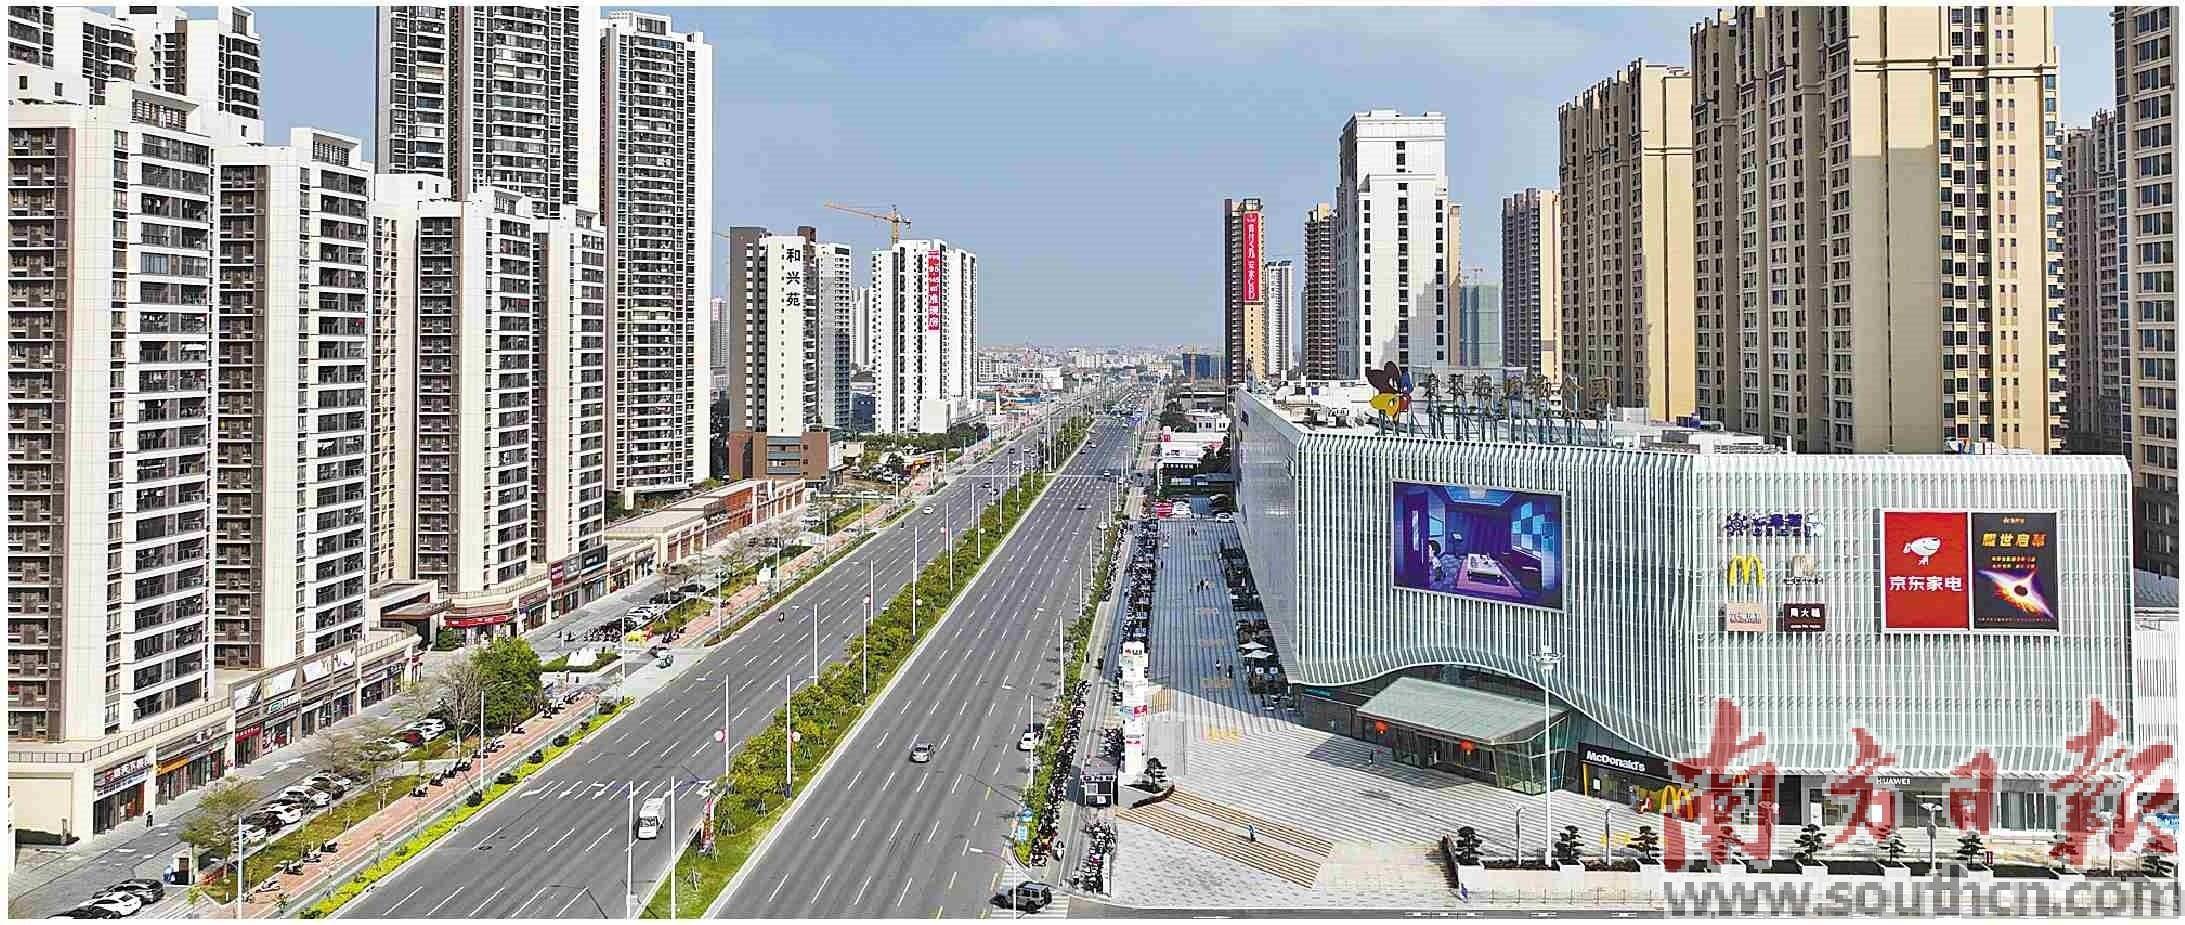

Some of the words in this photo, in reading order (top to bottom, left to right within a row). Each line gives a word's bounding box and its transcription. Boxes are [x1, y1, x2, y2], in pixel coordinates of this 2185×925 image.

[785, 248, 801, 307] 和兴苑
[1888, 575, 1963, 592] 京东家电
[1586, 749, 1646, 772] McDonald's
